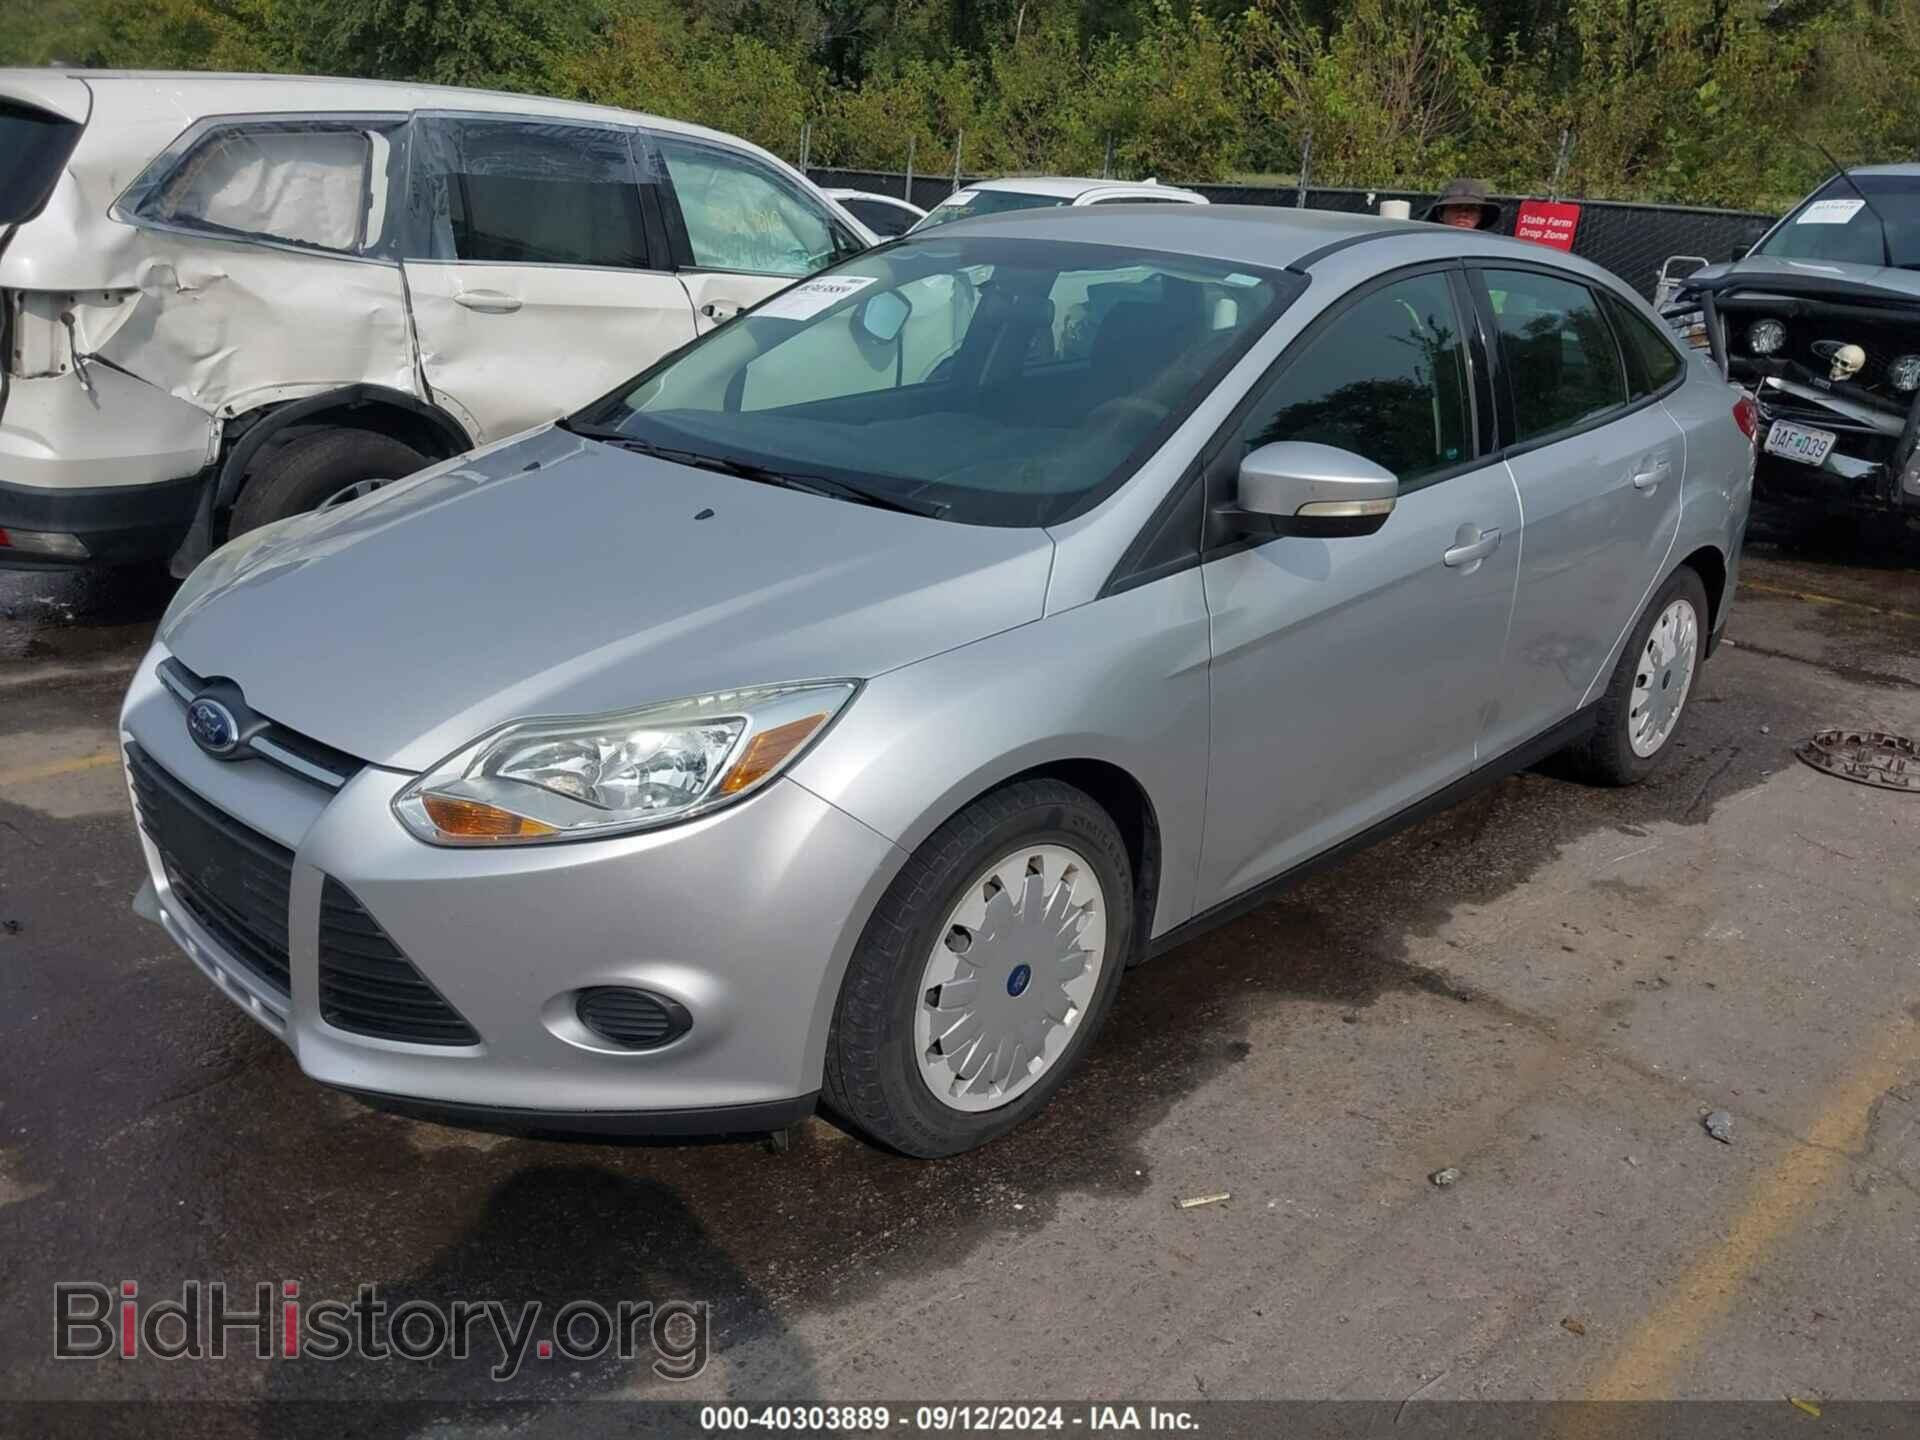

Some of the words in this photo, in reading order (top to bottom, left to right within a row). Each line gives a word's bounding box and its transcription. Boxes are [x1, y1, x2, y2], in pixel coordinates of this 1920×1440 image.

[1521, 214, 1546, 225] State
[1547, 217, 1573, 227] Farm
[1519, 227, 1542, 239] Drop
[1543, 229, 1569, 240] Zone
